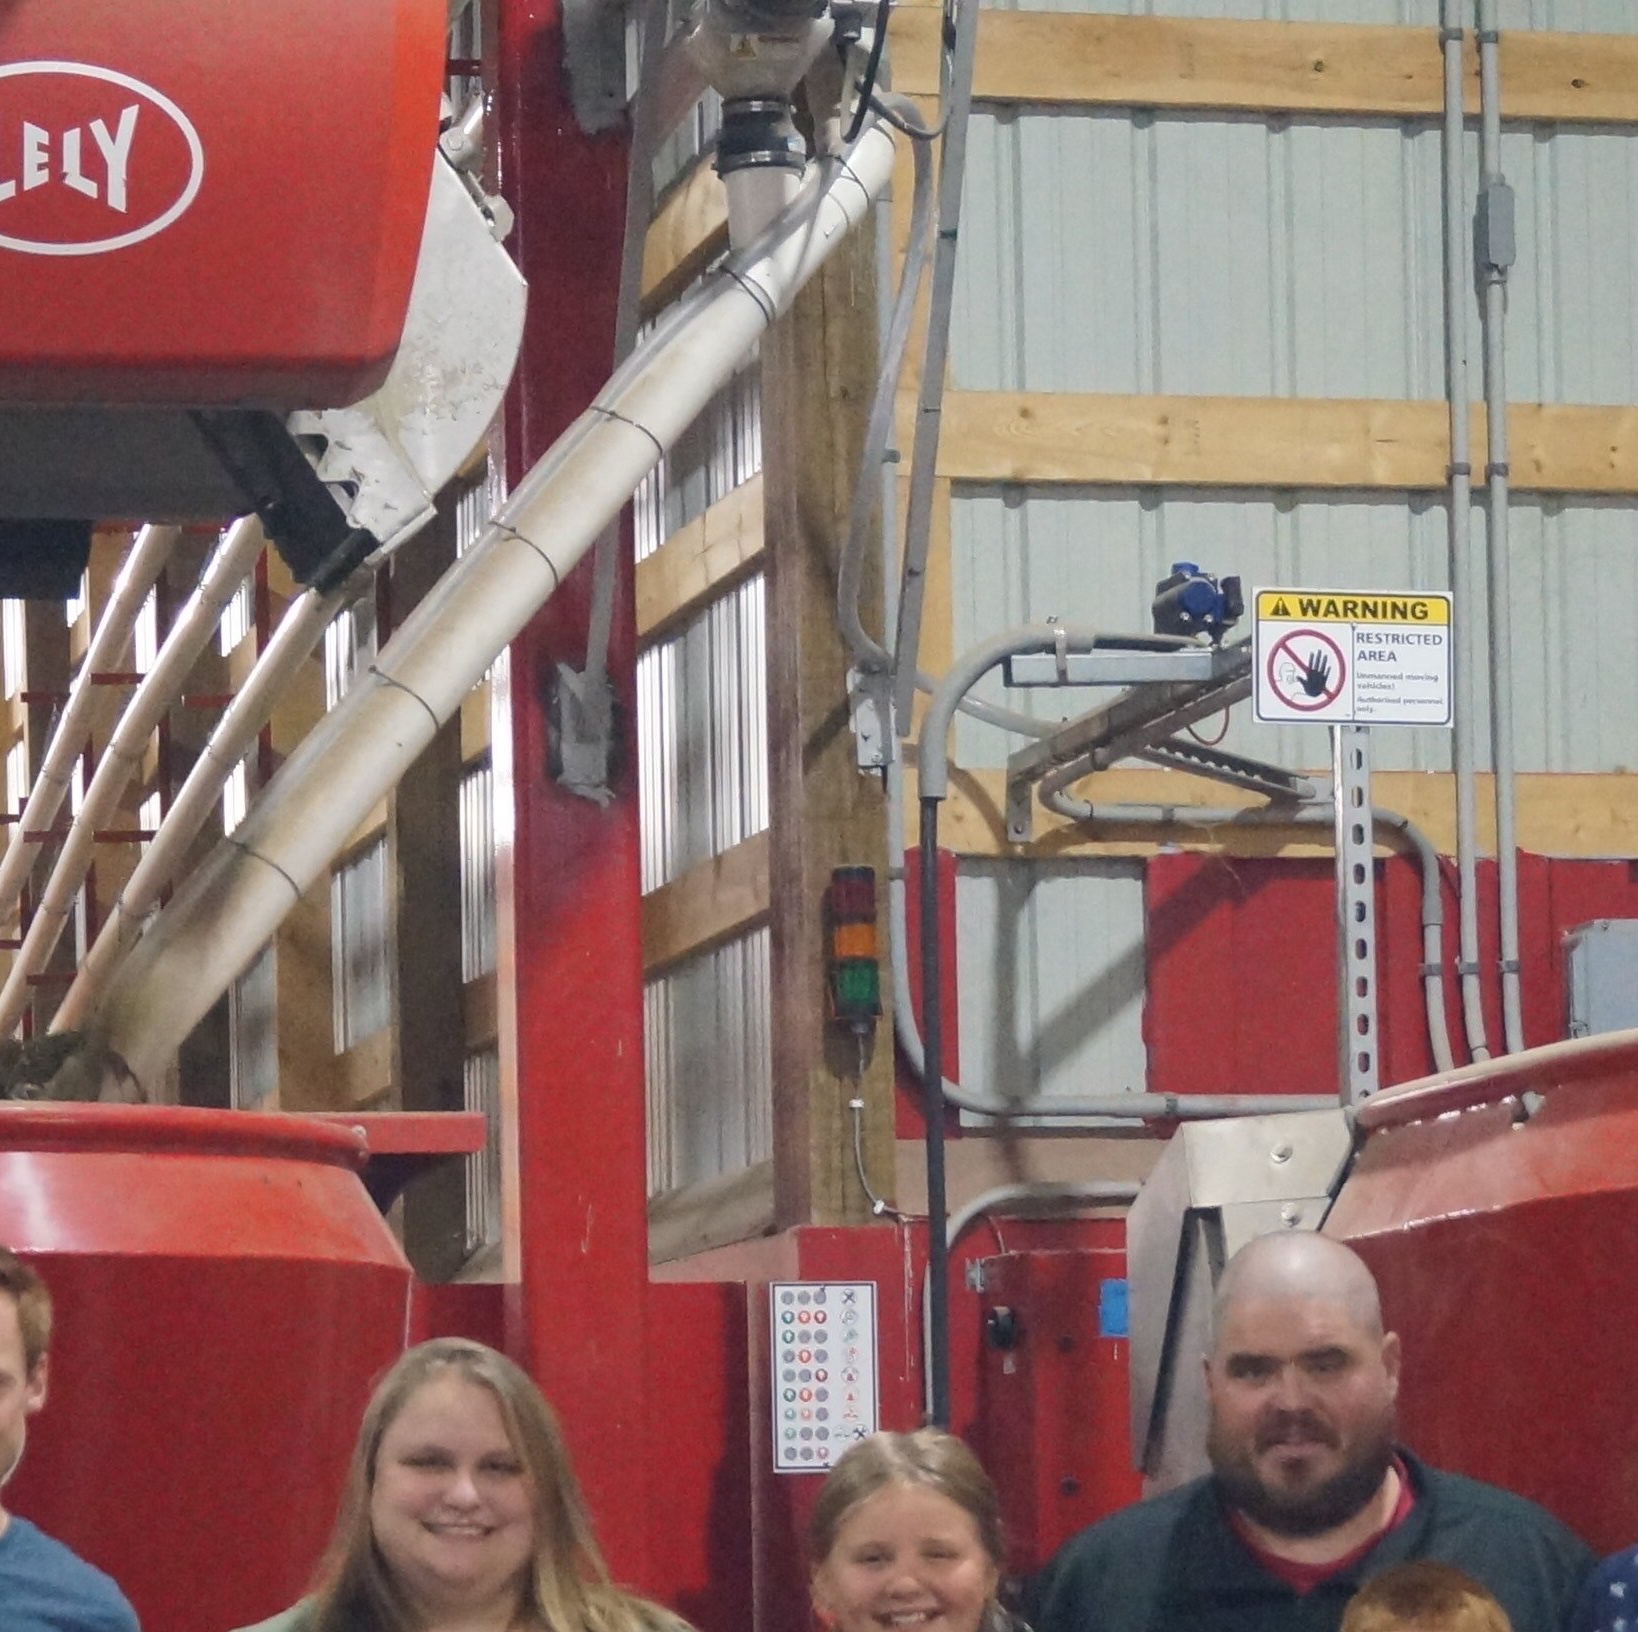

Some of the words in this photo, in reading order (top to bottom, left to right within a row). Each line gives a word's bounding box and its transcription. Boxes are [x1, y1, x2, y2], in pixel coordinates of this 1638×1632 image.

[1298, 597, 1429, 621] WARNING
[1356, 632, 1443, 646] RESTRICTED
[1357, 650, 1397, 662] AREA
